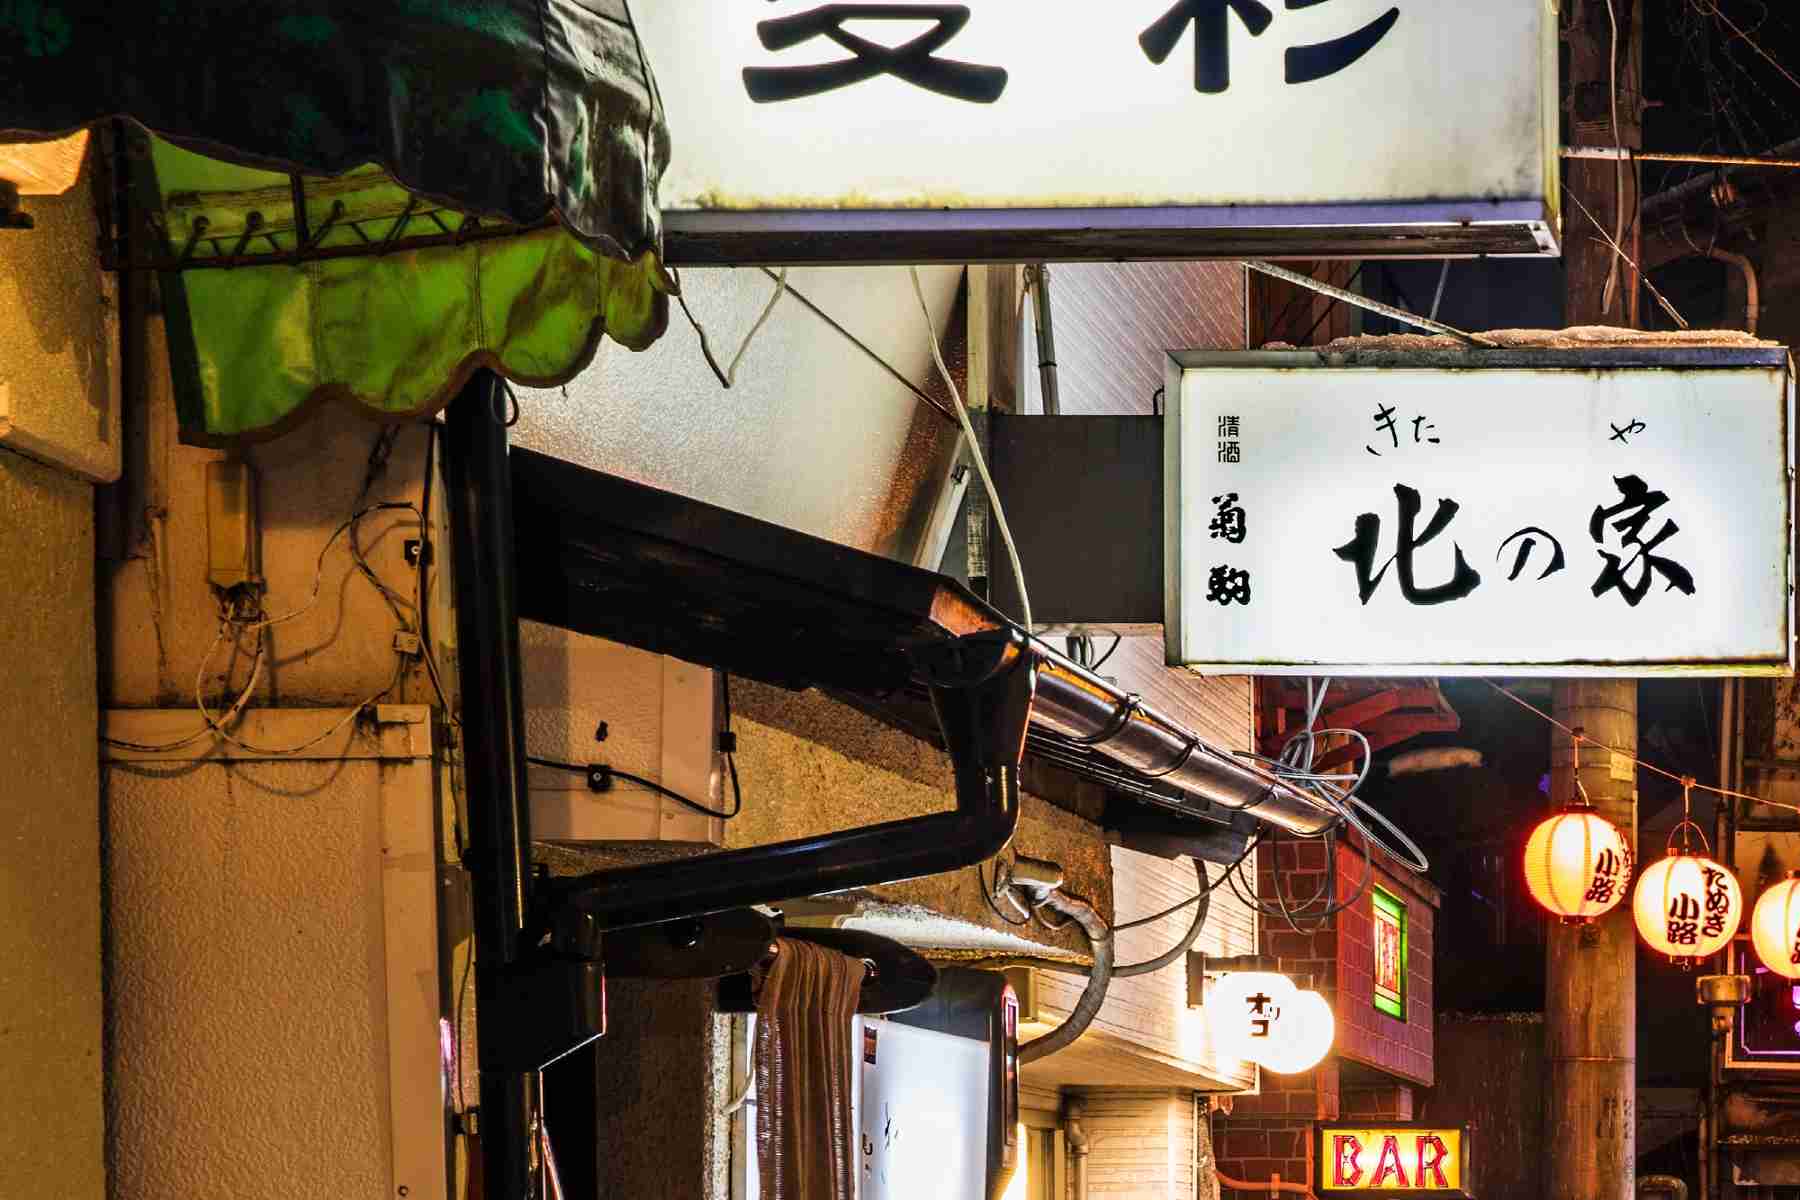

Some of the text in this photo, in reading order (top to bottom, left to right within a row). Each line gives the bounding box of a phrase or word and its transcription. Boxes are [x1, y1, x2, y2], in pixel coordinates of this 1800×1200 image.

[1364, 402, 1647, 457] きた や
[1205, 414, 1252, 607] 清酒 菊駒
[1331, 473, 1697, 607] 北の家
[1585, 847, 1620, 904] 小路
[1666, 892, 1700, 945] 小路
[1331, 1133, 1450, 1189] BAR
